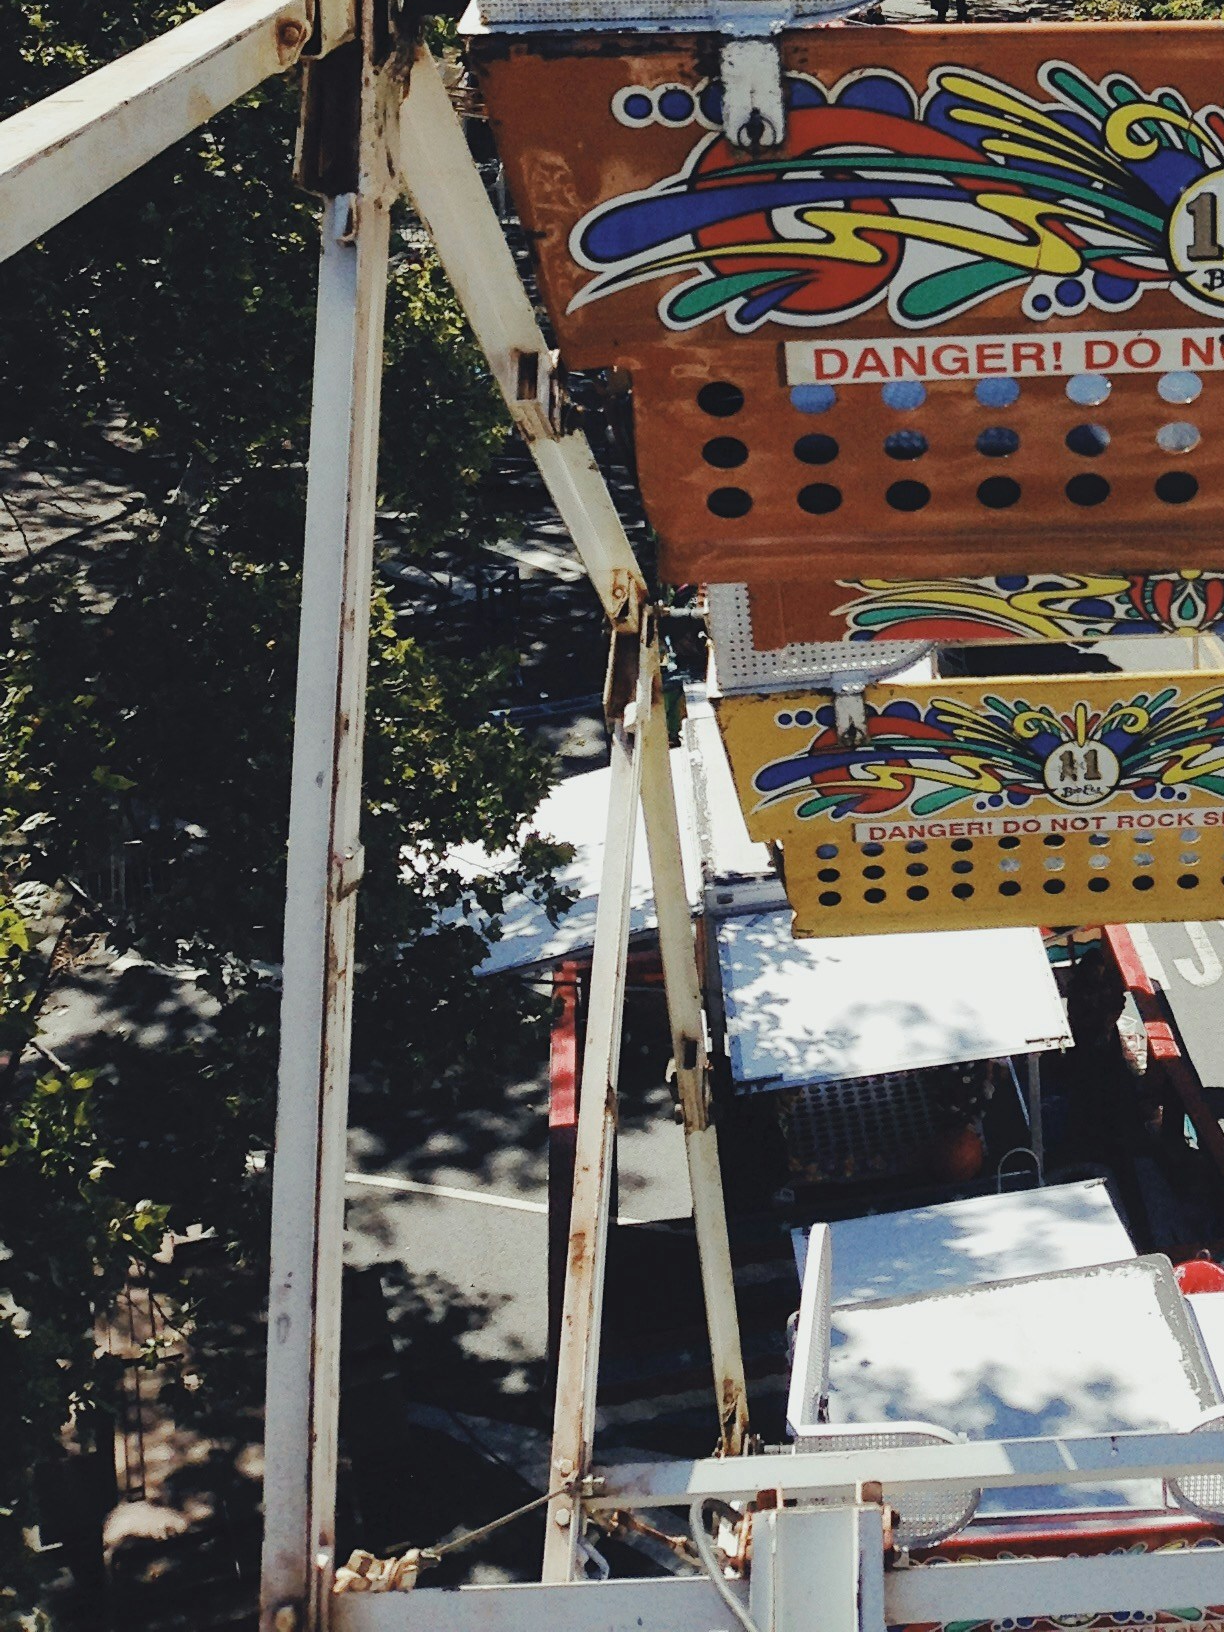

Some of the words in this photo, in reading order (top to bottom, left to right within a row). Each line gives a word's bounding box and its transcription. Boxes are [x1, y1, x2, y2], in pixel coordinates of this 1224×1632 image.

[813, 341, 1063, 381] DANGER!
[1084, 338, 1162, 370] DO
[1059, 748, 1102, 782] 11
[869, 821, 993, 841] DANGER!
[1003, 819, 1041, 834] DO
[1051, 816, 1107, 831] NOT
[1117, 813, 1195, 829] ROCK
